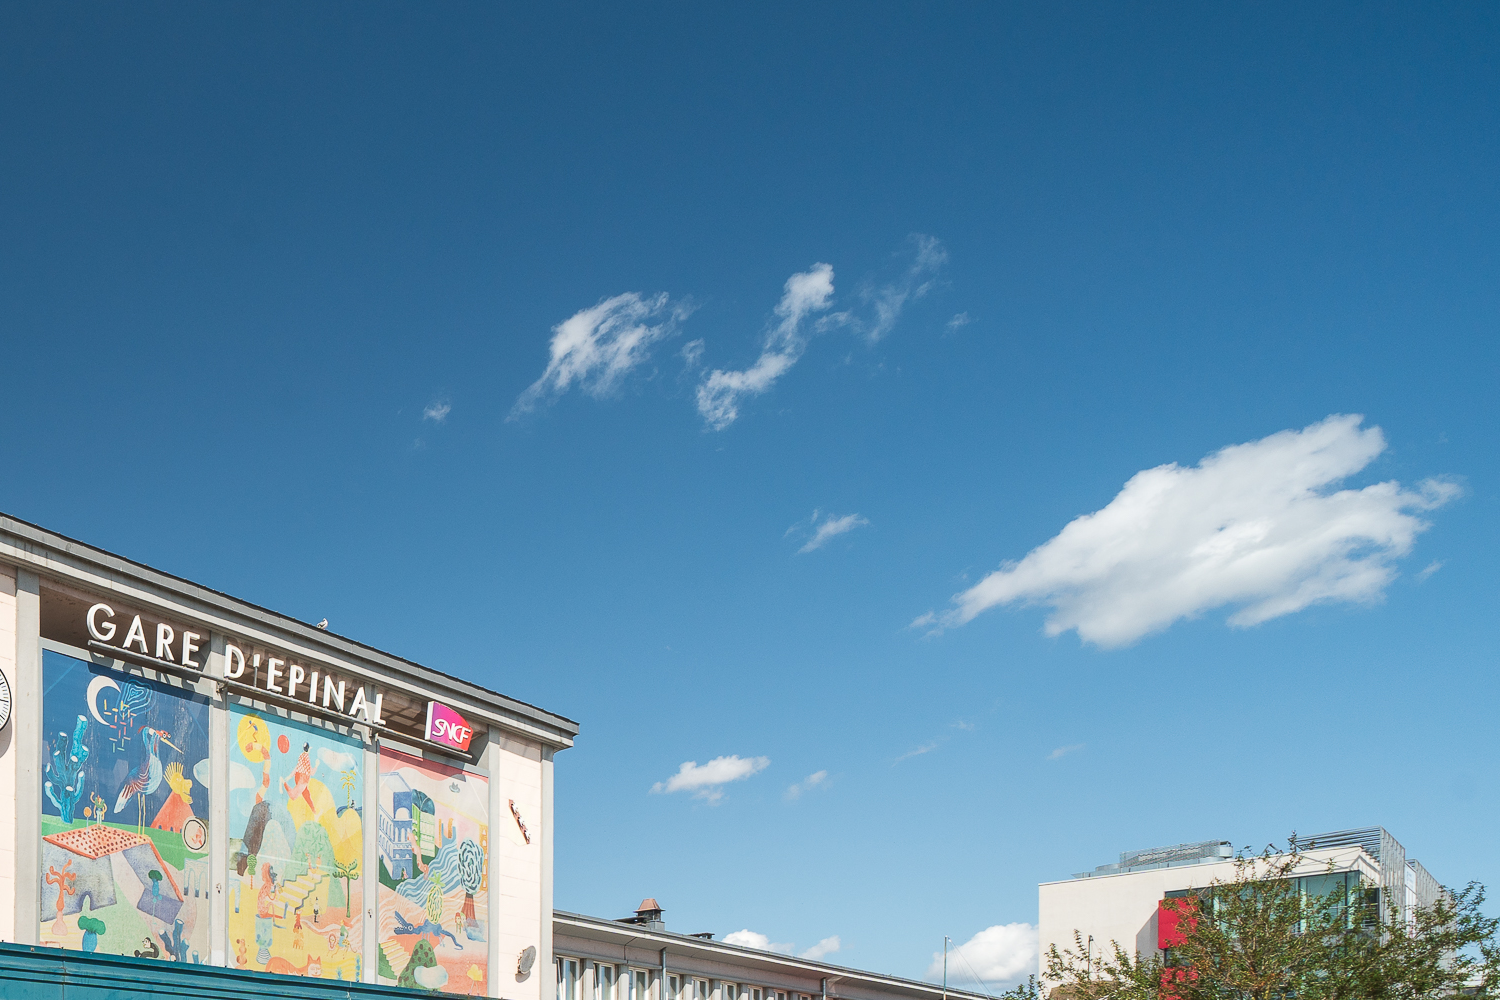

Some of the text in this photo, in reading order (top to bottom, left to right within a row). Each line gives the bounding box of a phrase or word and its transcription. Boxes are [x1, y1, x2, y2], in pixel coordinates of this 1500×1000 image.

[86, 603, 386, 725] GARE D'EPINAL
[431, 717, 472, 744] SNCF
